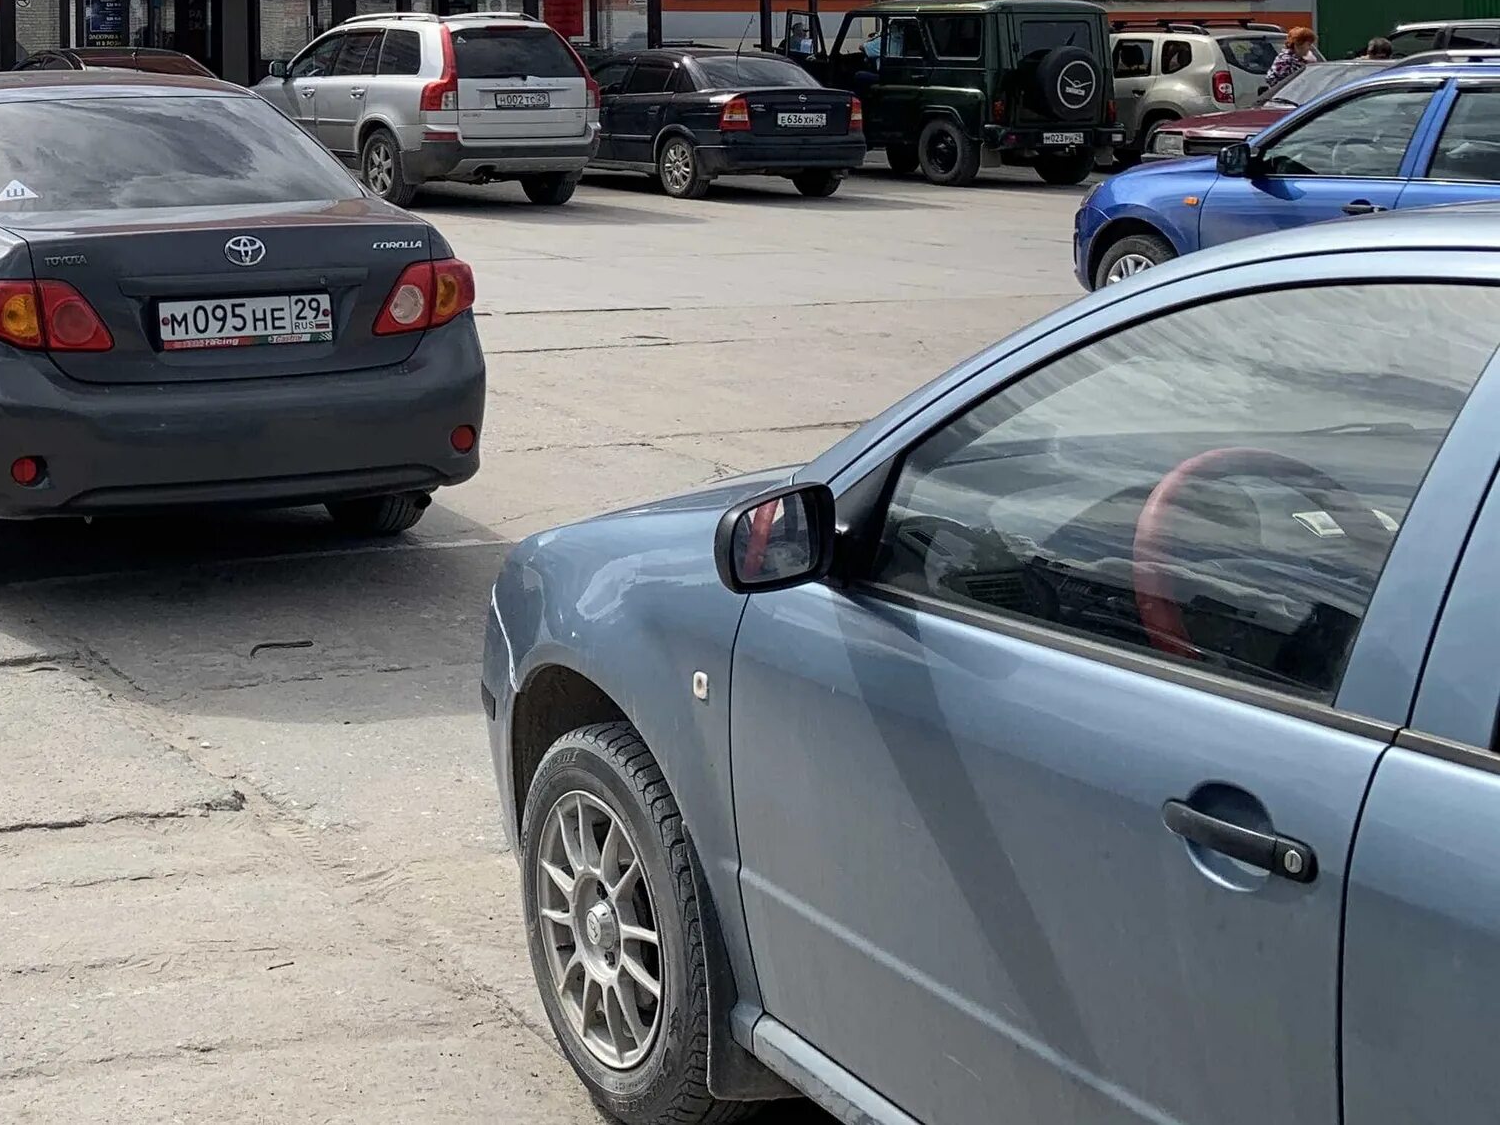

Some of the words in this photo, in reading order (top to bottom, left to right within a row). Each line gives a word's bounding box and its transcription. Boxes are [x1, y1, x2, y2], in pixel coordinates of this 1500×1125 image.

[372, 240, 423, 250] COROLLA
[44, 254, 88, 267] TOYOTA
[294, 320, 315, 331] RUS
